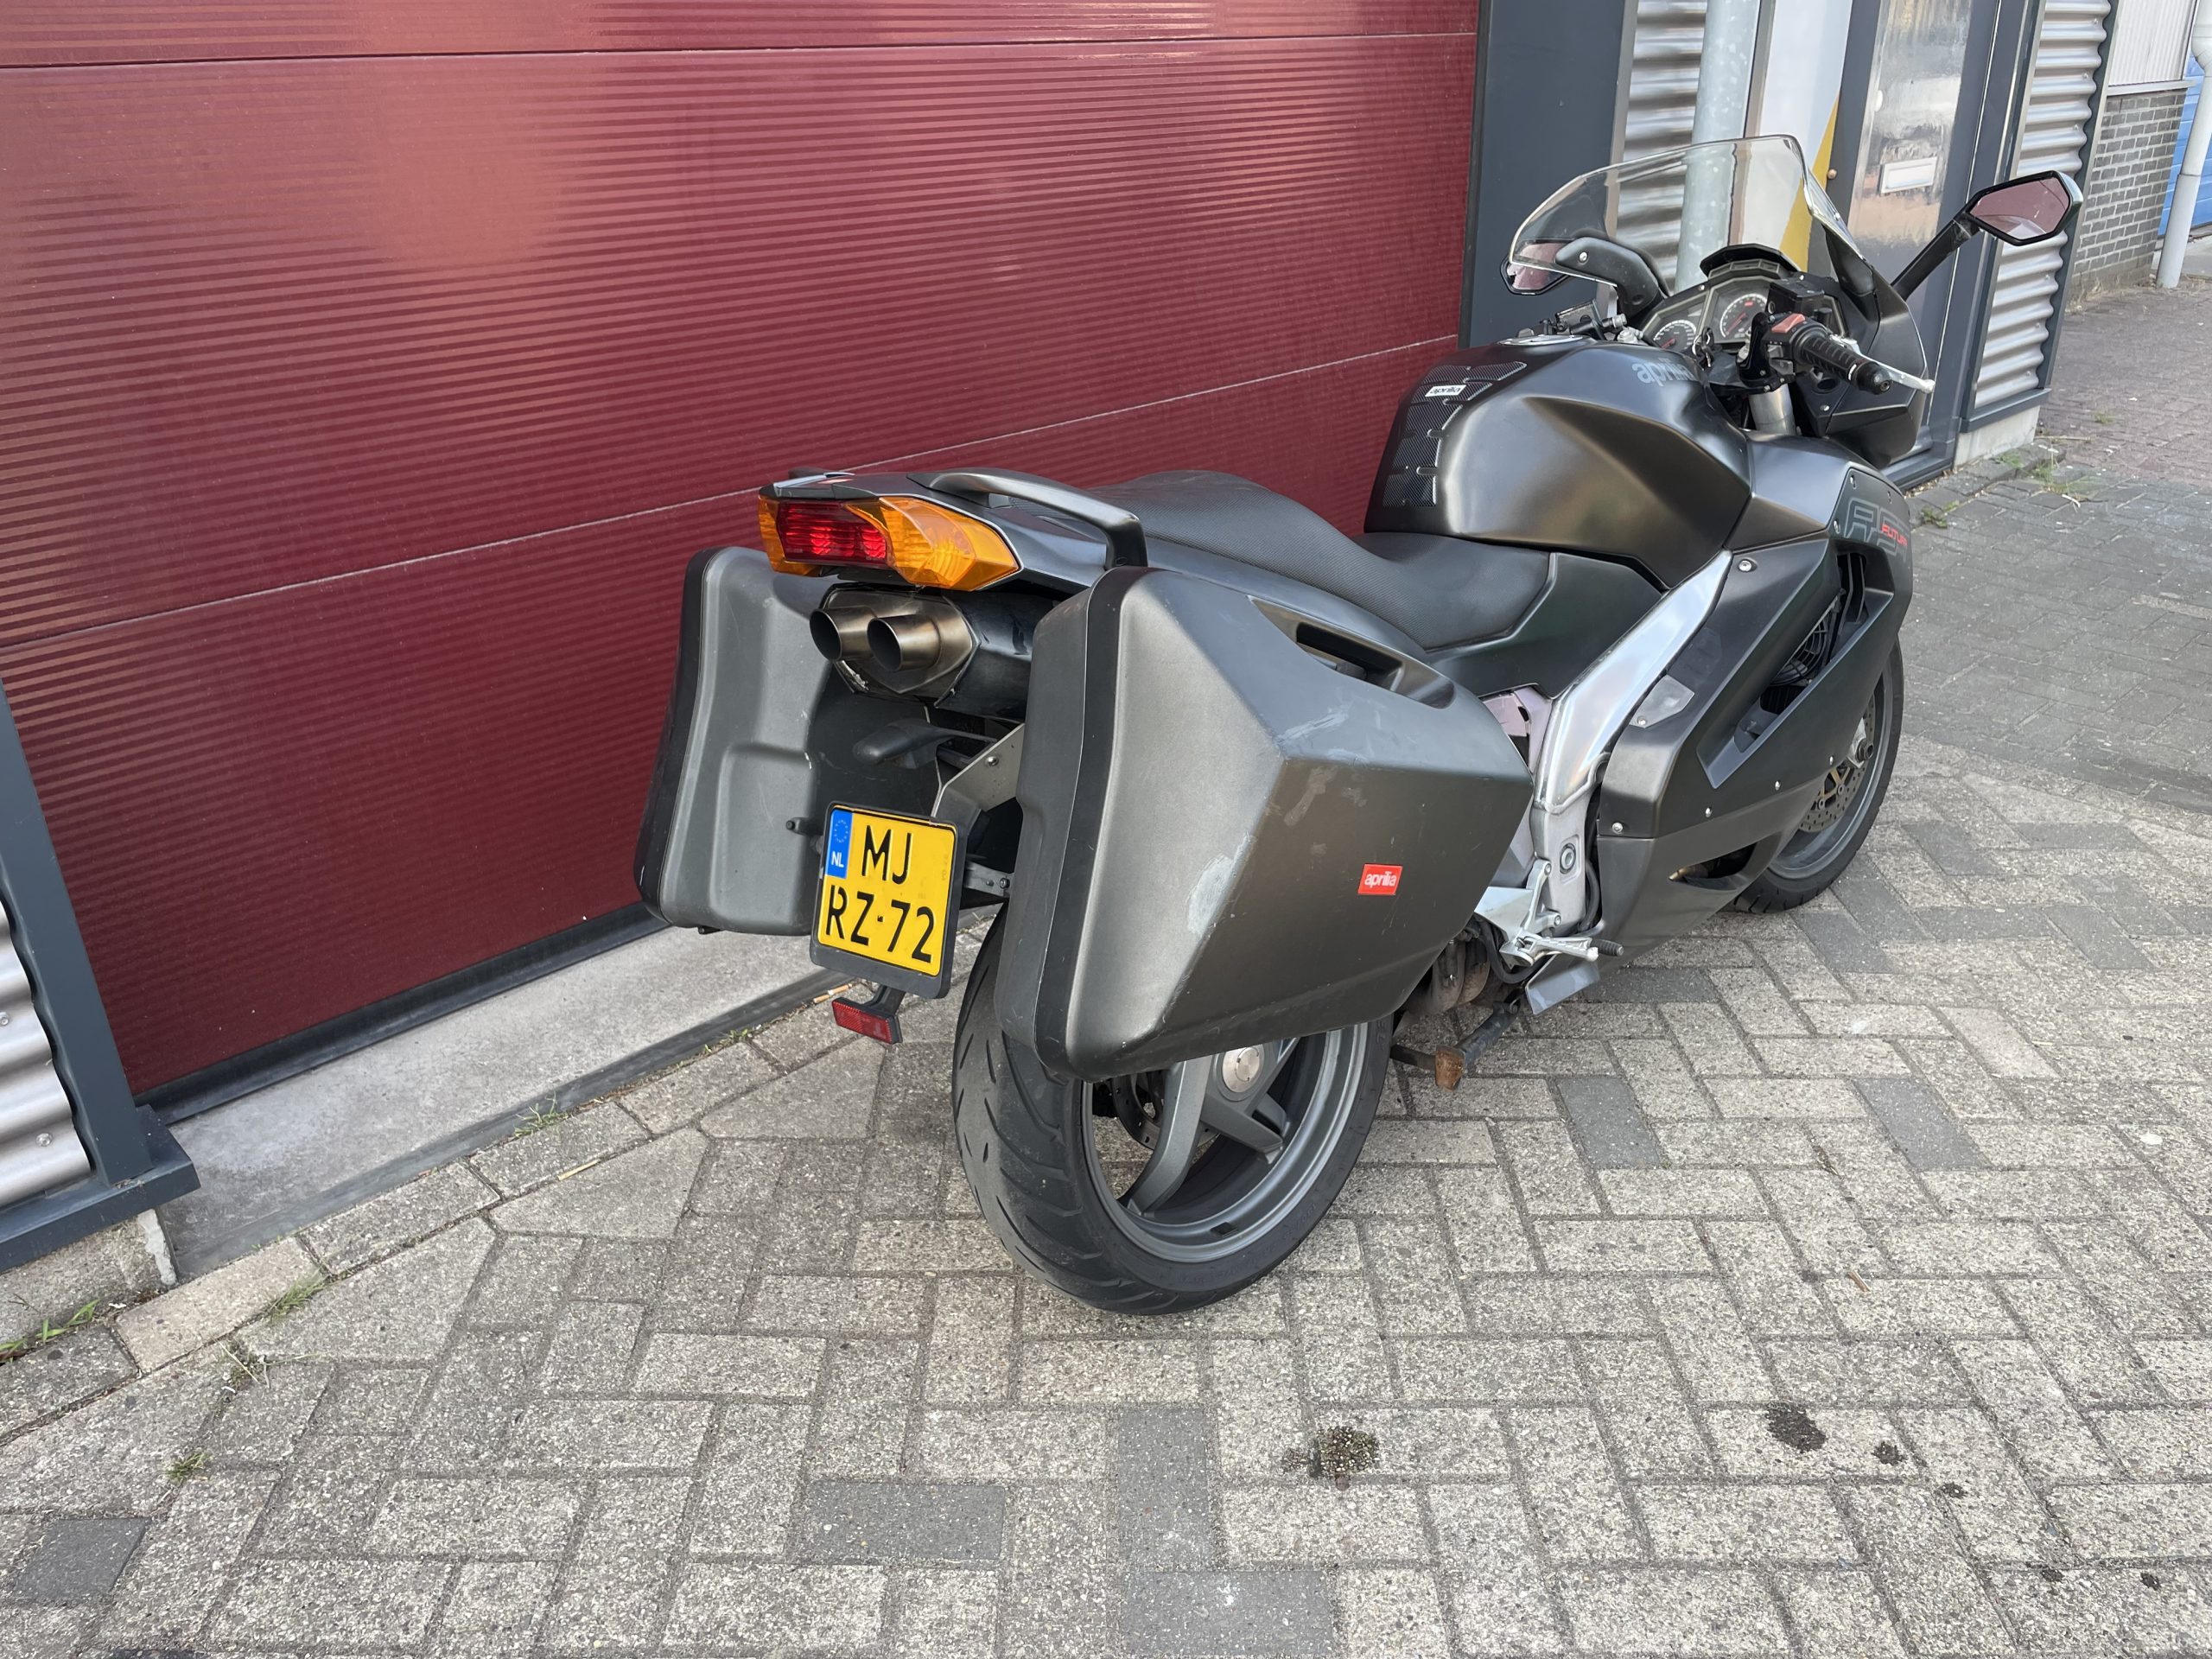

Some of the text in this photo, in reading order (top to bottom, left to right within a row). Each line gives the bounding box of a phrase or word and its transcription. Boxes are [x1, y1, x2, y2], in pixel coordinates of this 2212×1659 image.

[831, 851, 844, 868] NL
[861, 825, 912, 885] MJ
[1364, 871, 1397, 888] aprilia
